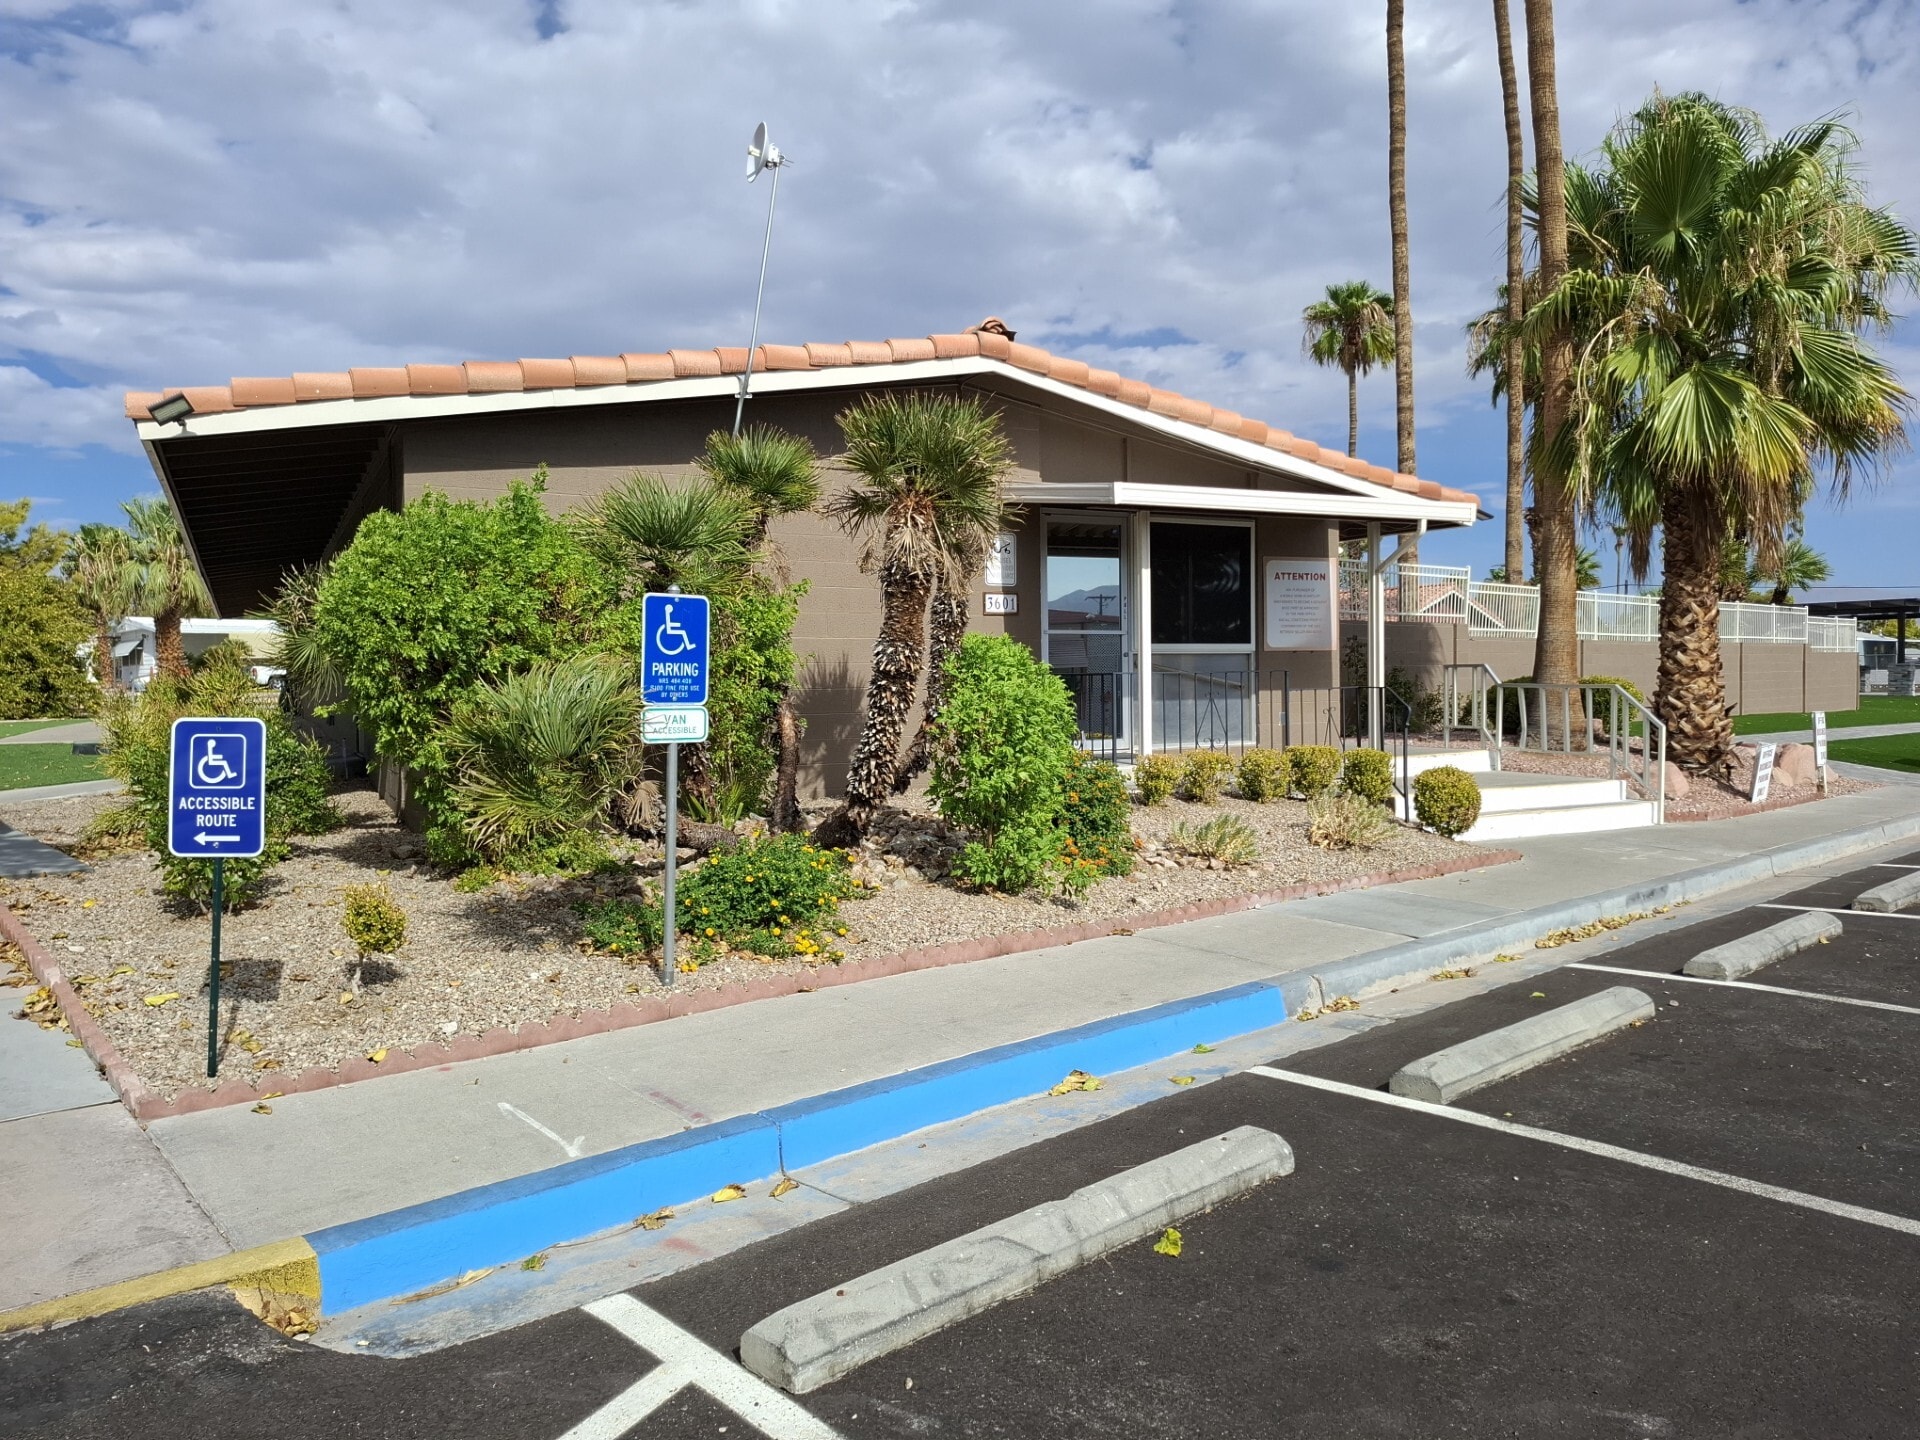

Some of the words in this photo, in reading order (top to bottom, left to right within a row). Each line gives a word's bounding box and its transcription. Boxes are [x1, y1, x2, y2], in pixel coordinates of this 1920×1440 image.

[1274, 572, 1326, 581] ATTENTION
[987, 596, 1015, 610] 3601
[652, 662, 699, 676] PARKING
[664, 714, 686, 725] VAN
[179, 797, 255, 809] ACCESSIBLE
[196, 814, 236, 827] ROUTE
